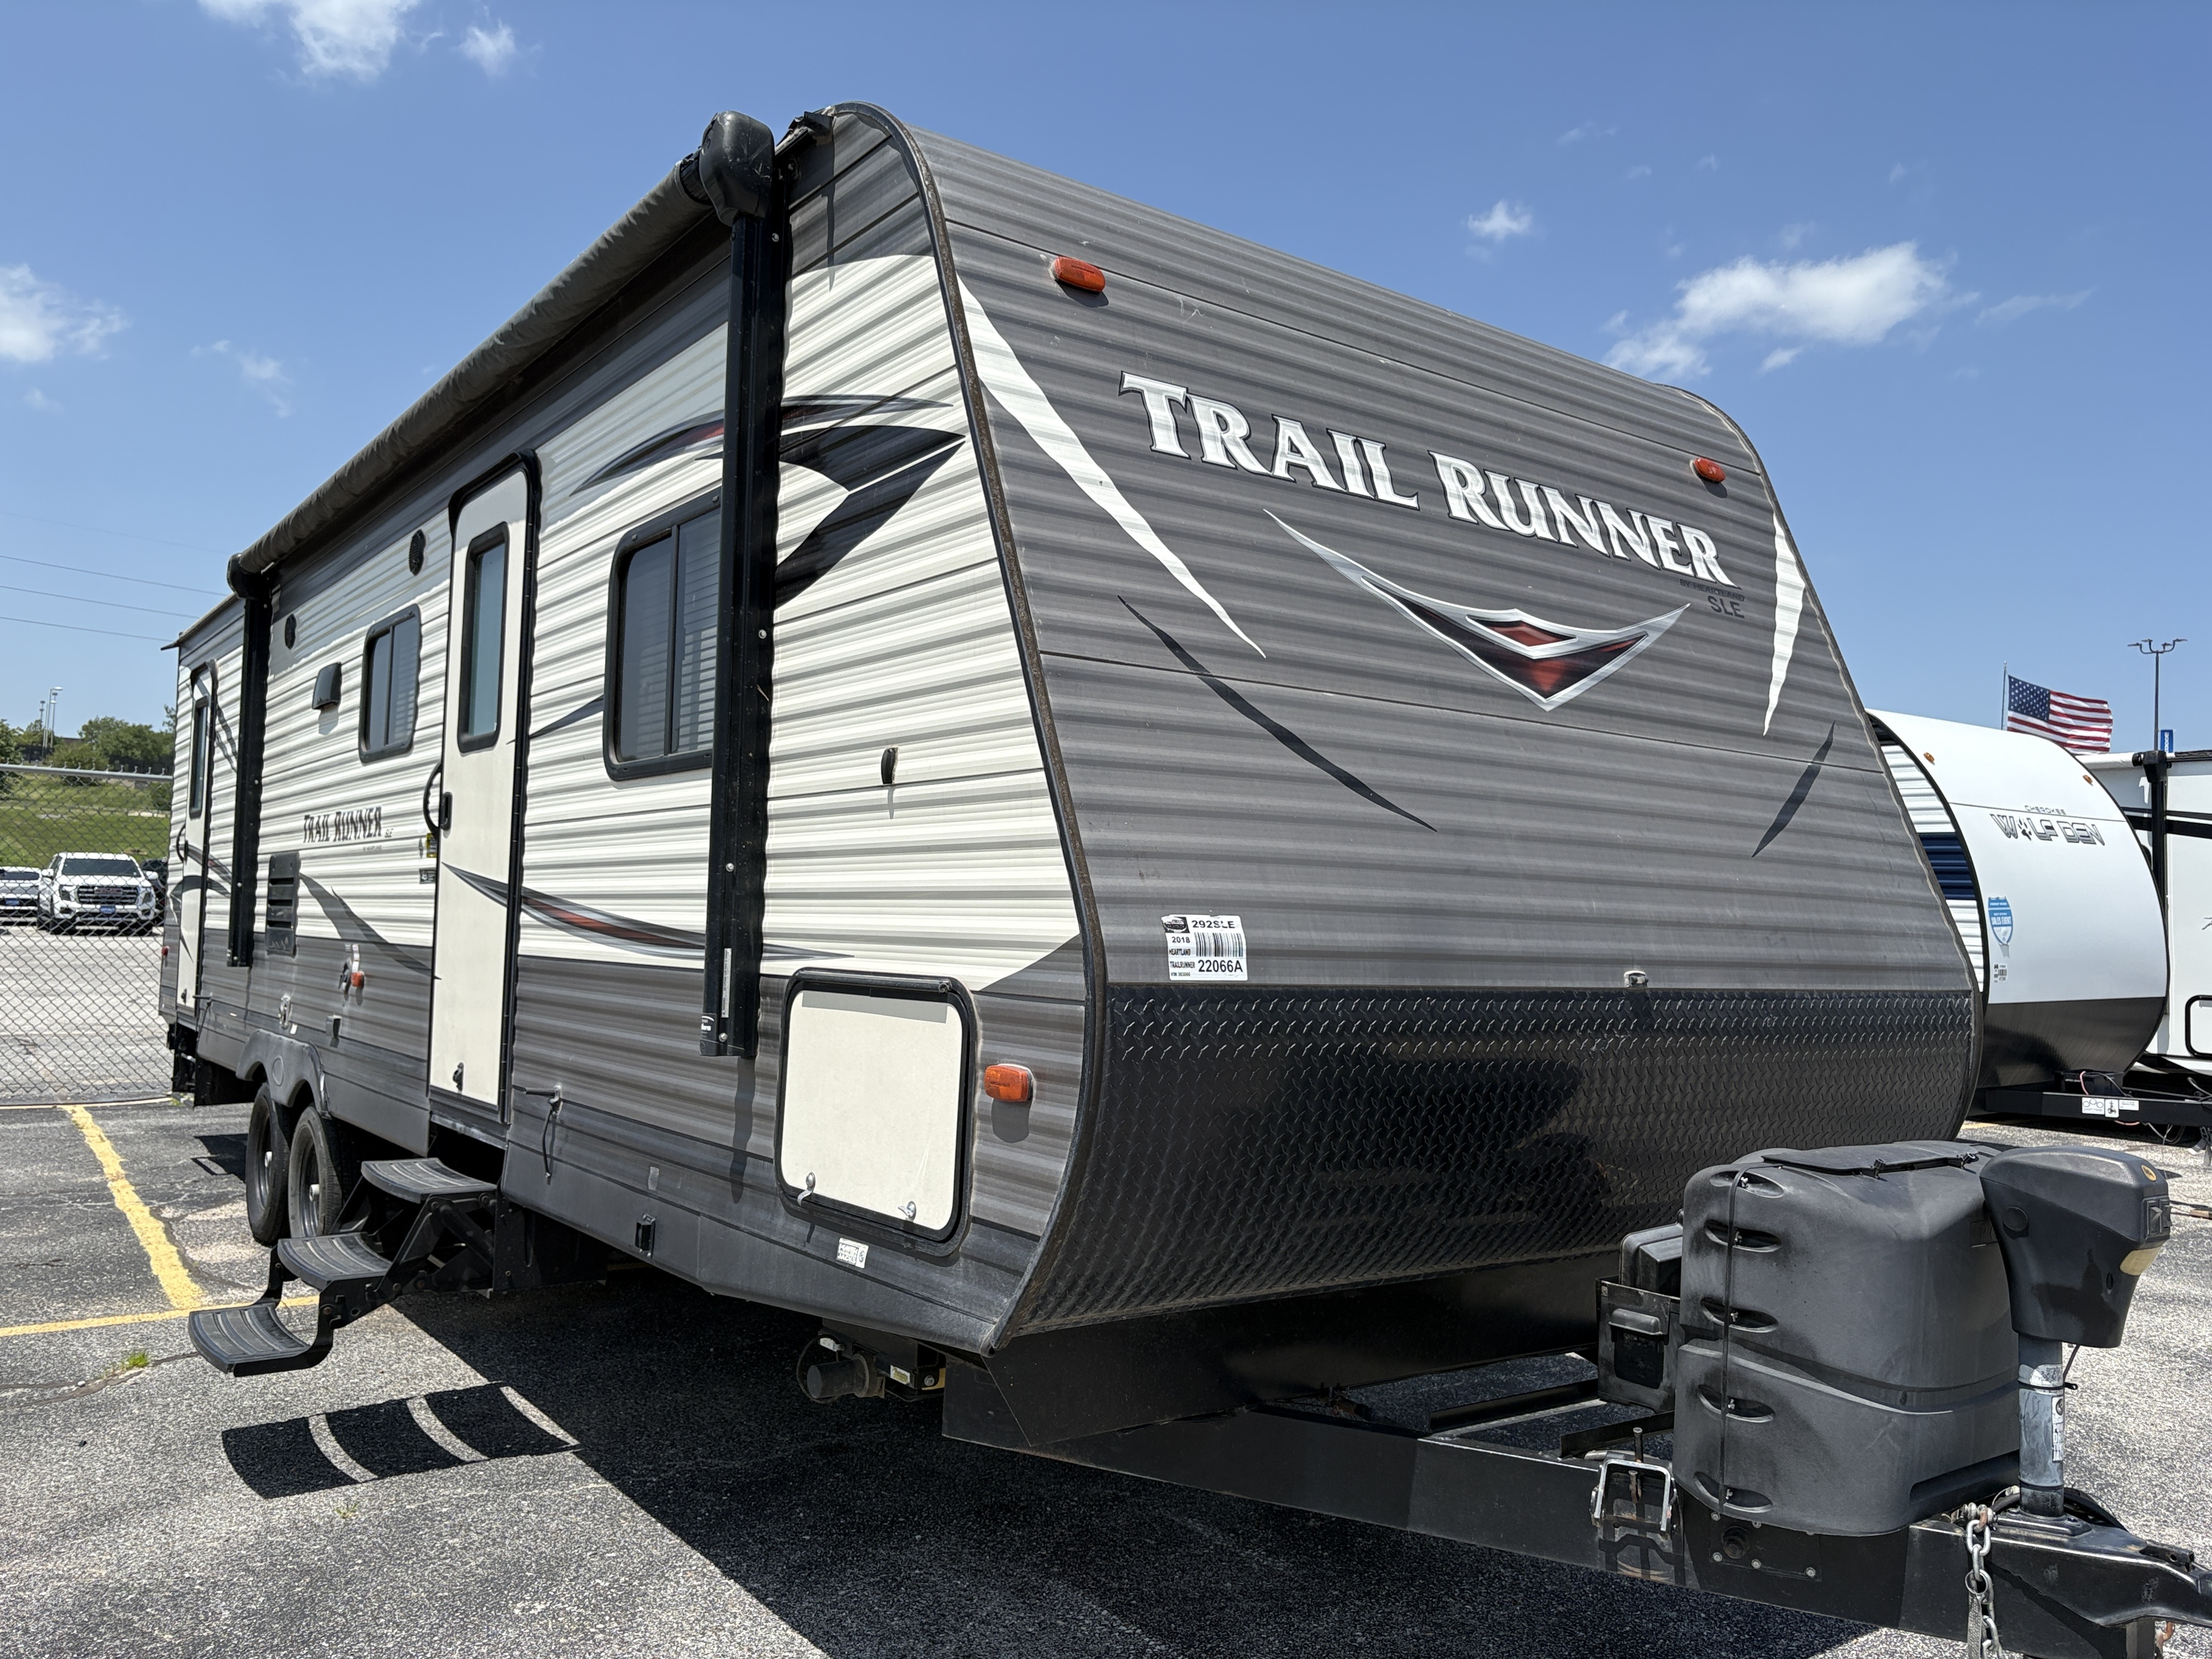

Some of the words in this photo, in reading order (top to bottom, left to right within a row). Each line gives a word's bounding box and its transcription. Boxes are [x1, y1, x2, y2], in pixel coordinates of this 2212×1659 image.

[1119, 371, 1420, 511] TRAIL
[1427, 450, 1741, 590] RUNNER
[1679, 578, 1691, 588] BY
[1693, 583, 1746, 602] HEARTLAND
[1707, 595, 1745, 619] SLE
[2024, 805, 2067, 815] CHEROKEE
[303, 814, 330, 844] TRAIL
[332, 806, 382, 843] RUNNER
[2056, 820, 2106, 846] DEN
[1191, 919, 1235, 929] 292SLE
[1197, 959, 1244, 973] 22066A
[837, 1253, 856, 1264] JACKS
